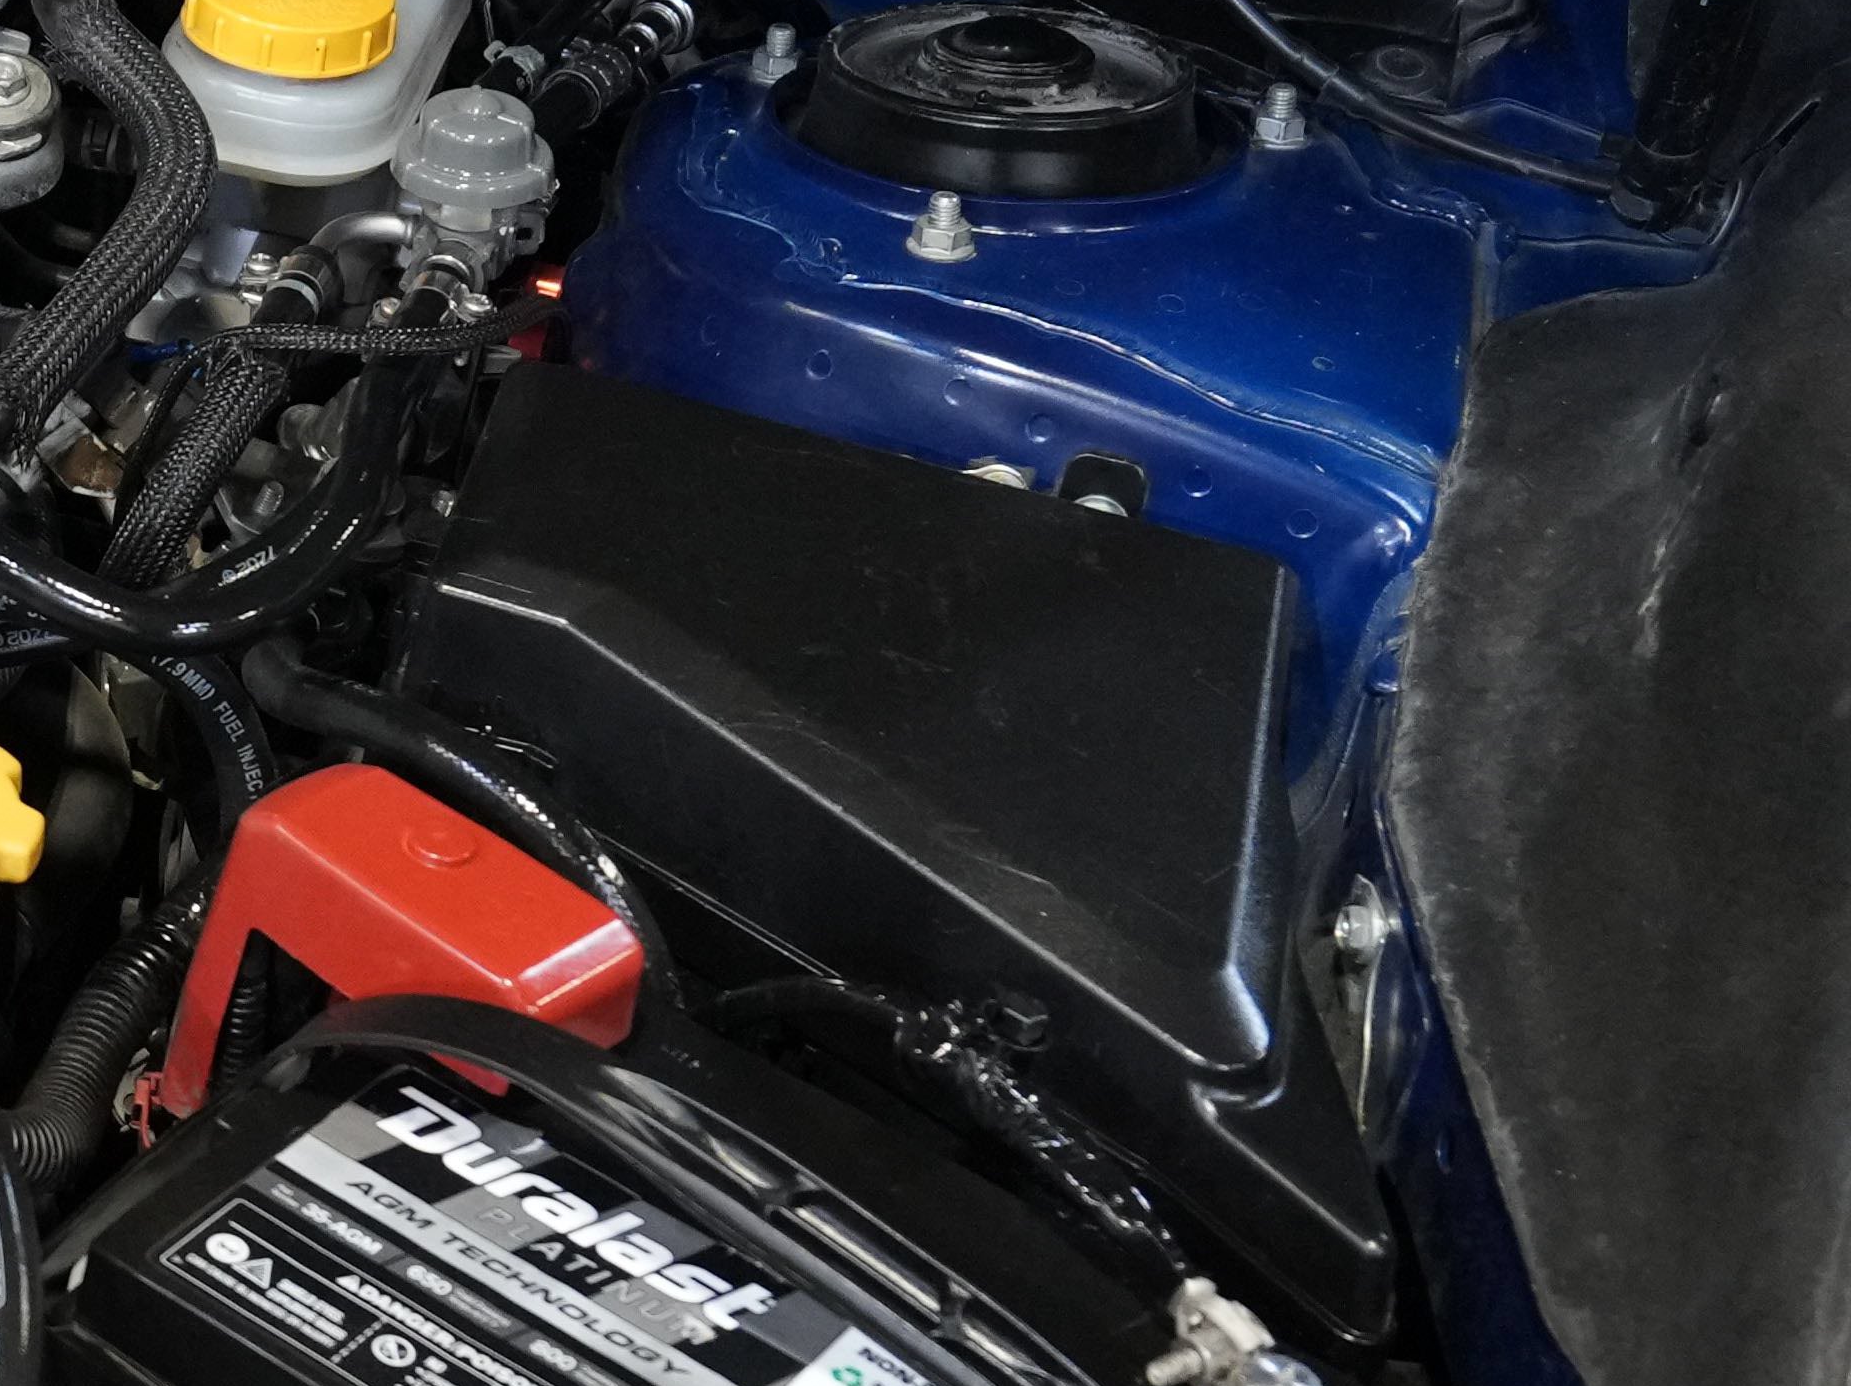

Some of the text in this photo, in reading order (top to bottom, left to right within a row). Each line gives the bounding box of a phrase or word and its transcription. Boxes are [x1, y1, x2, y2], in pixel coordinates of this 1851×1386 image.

[212, 700, 246, 743] FUEL
[236, 744, 265, 801] INJEC
[347, 1180, 435, 1231] AGM
[443, 1231, 693, 1379] TECHNOLOGY
[375, 1085, 779, 1331] Duralast
